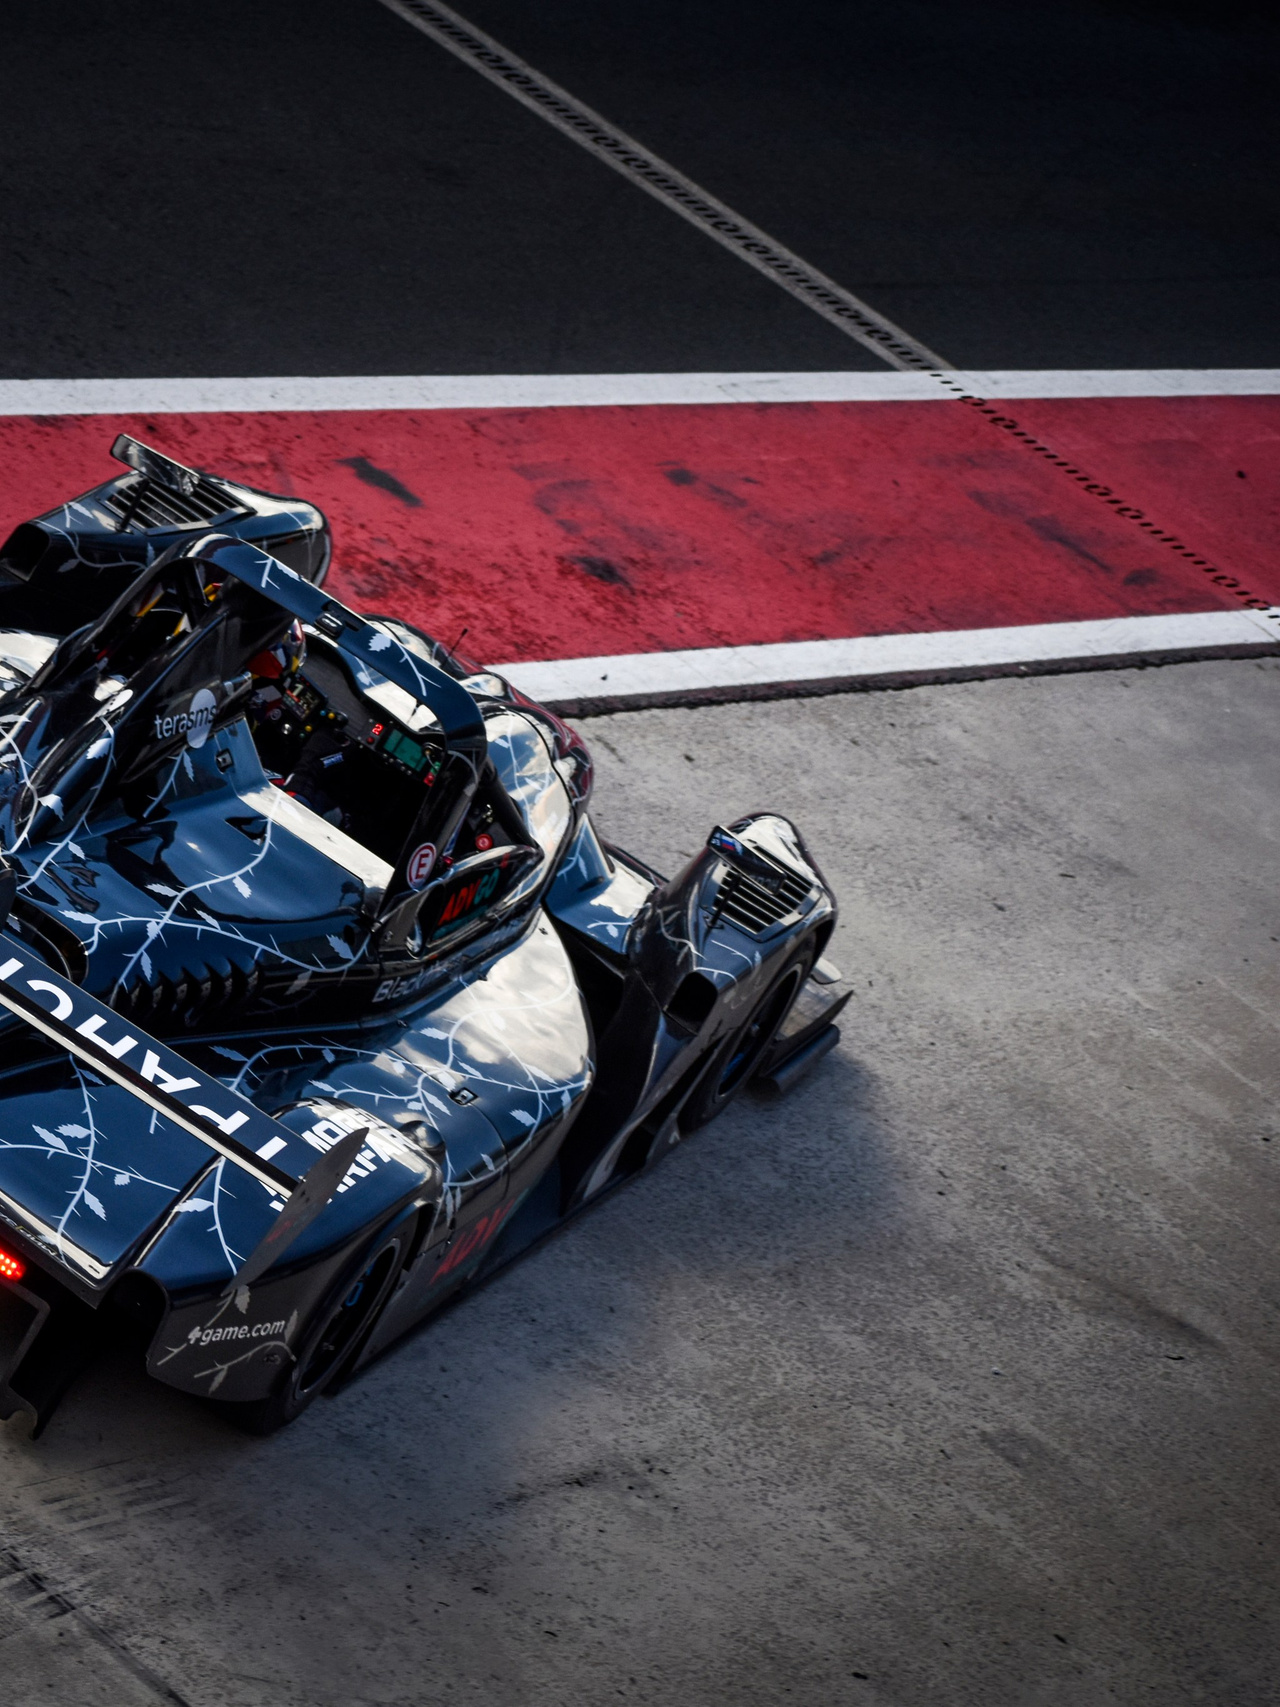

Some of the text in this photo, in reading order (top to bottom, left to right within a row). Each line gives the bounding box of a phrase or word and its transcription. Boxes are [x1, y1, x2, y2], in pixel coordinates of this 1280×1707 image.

[154, 704, 218, 740] terasms
[416, 853, 429, 880] E
[187, 1320, 286, 1346] 4game.com
